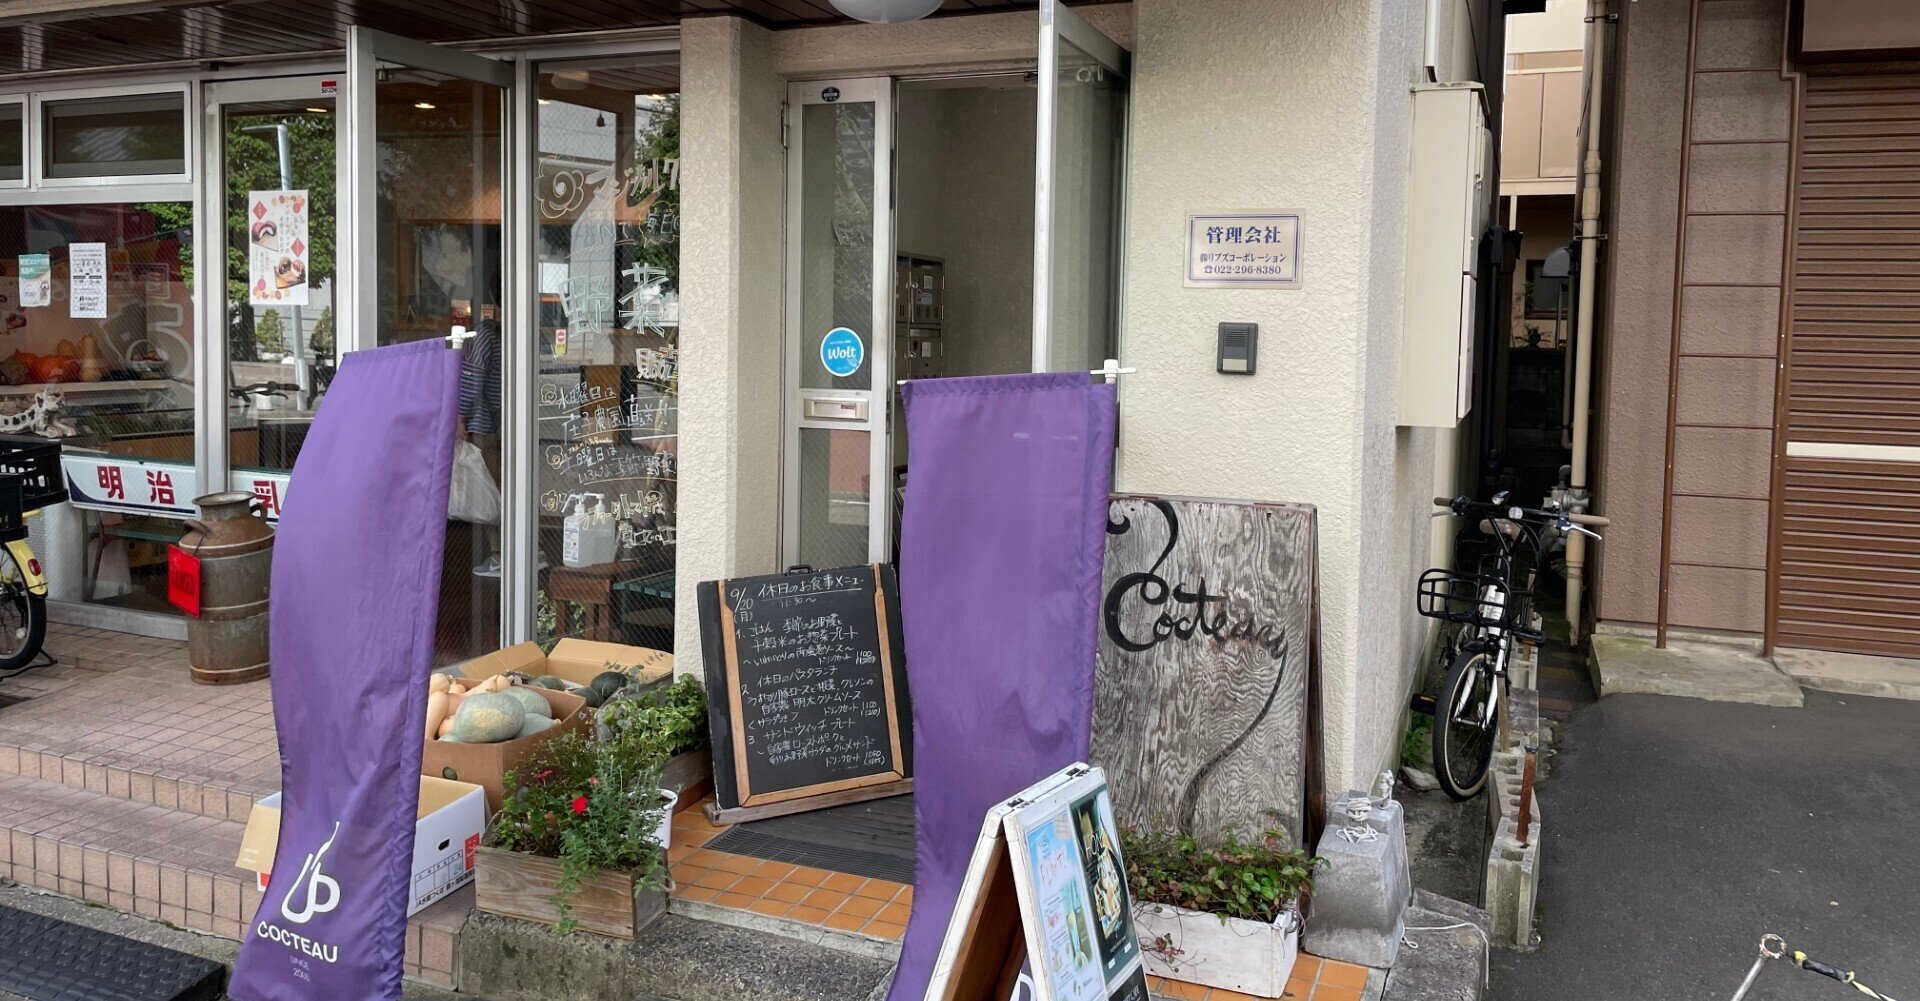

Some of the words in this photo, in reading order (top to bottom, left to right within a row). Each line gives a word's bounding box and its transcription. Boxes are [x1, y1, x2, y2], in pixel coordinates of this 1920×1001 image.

[1206, 226, 1281, 244] 管理会社
[558, 262, 669, 338] 野菜
[828, 346, 856, 360] Wolt
[97, 466, 175, 505] 明治
[758, 574, 864, 598] 休日のお食事メニュー
[757, 666, 838, 688] 休日のパスタランチ
[257, 920, 338, 963] COCTEAU
